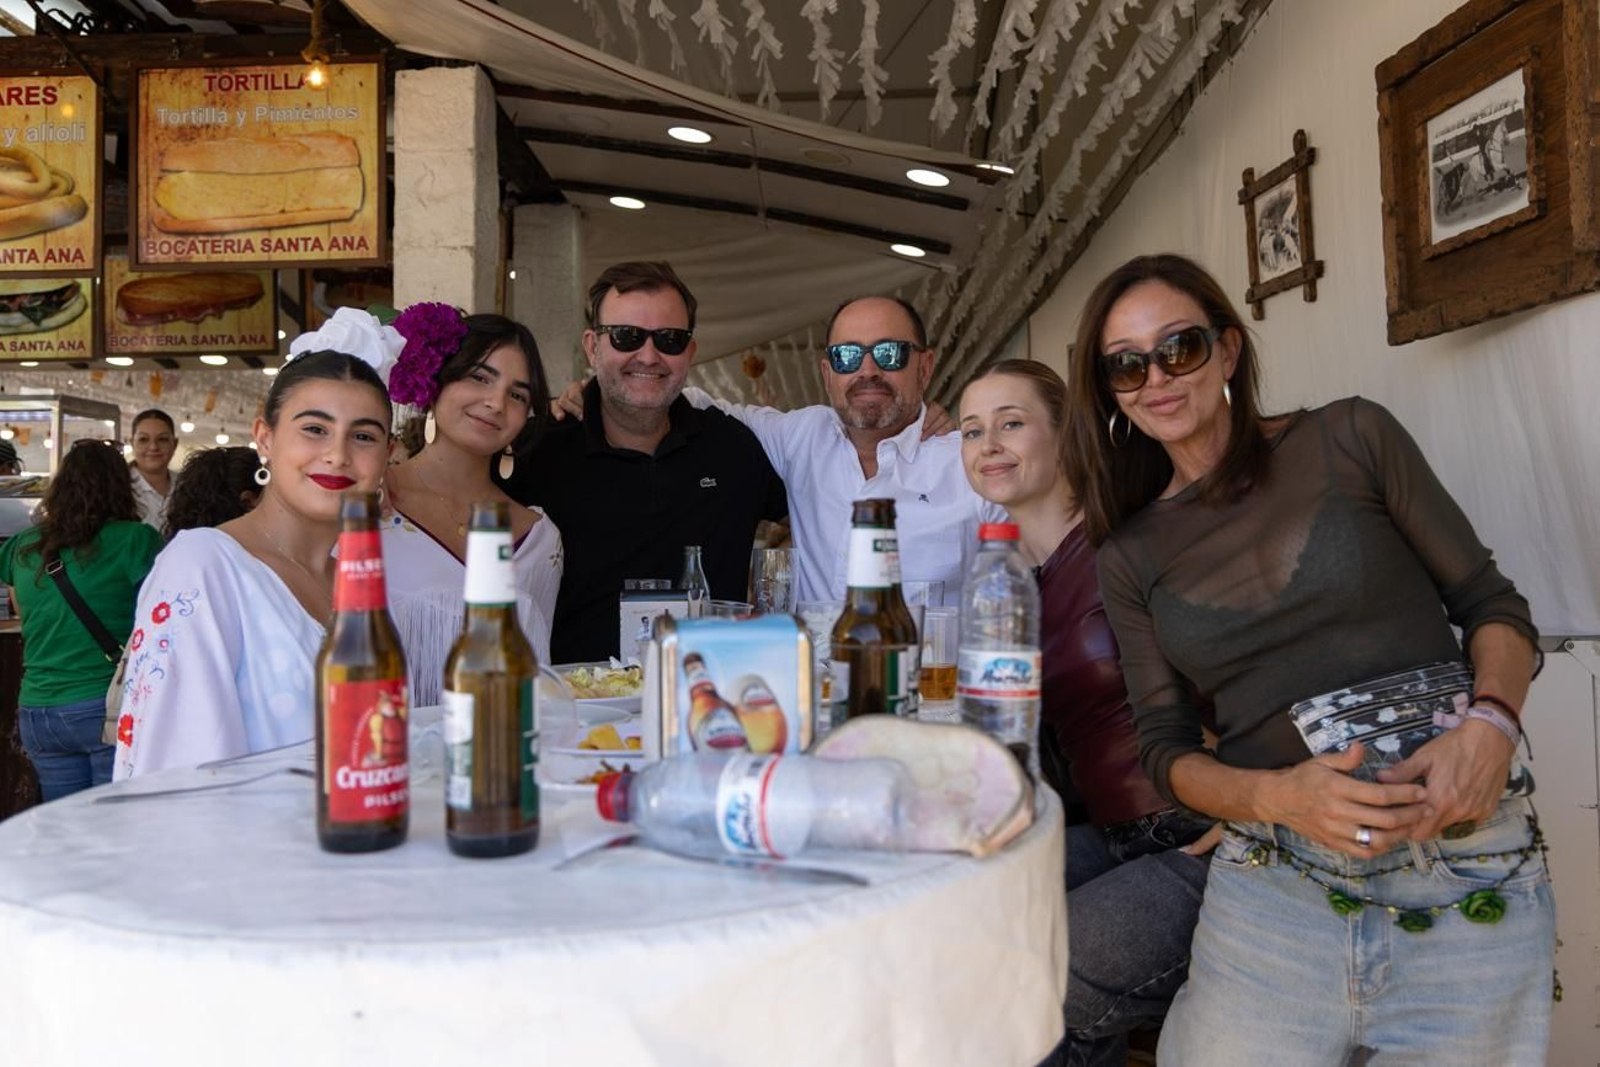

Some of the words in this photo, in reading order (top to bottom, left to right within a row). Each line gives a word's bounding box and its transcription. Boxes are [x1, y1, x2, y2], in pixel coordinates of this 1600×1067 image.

[0, 86, 58, 106] RES
[156, 108, 228, 126] Tortilla
[236, 109, 247, 128] y
[255, 104, 361, 123] Pimientos
[4, 127, 18, 148] y
[27, 119, 86, 142] alioli
[146, 238, 255, 256] BOCATERIA
[260, 236, 324, 253] SANTA
[329, 235, 370, 252] ANA
[0, 249, 39, 264] NTA
[45, 248, 85, 263] ANA
[10, 341, 54, 352] SANTA
[57, 340, 86, 351] ANA
[109, 334, 188, 347] BOCATERIA
[191, 334, 236, 347] SANTA
[240, 334, 268, 346] ANA
